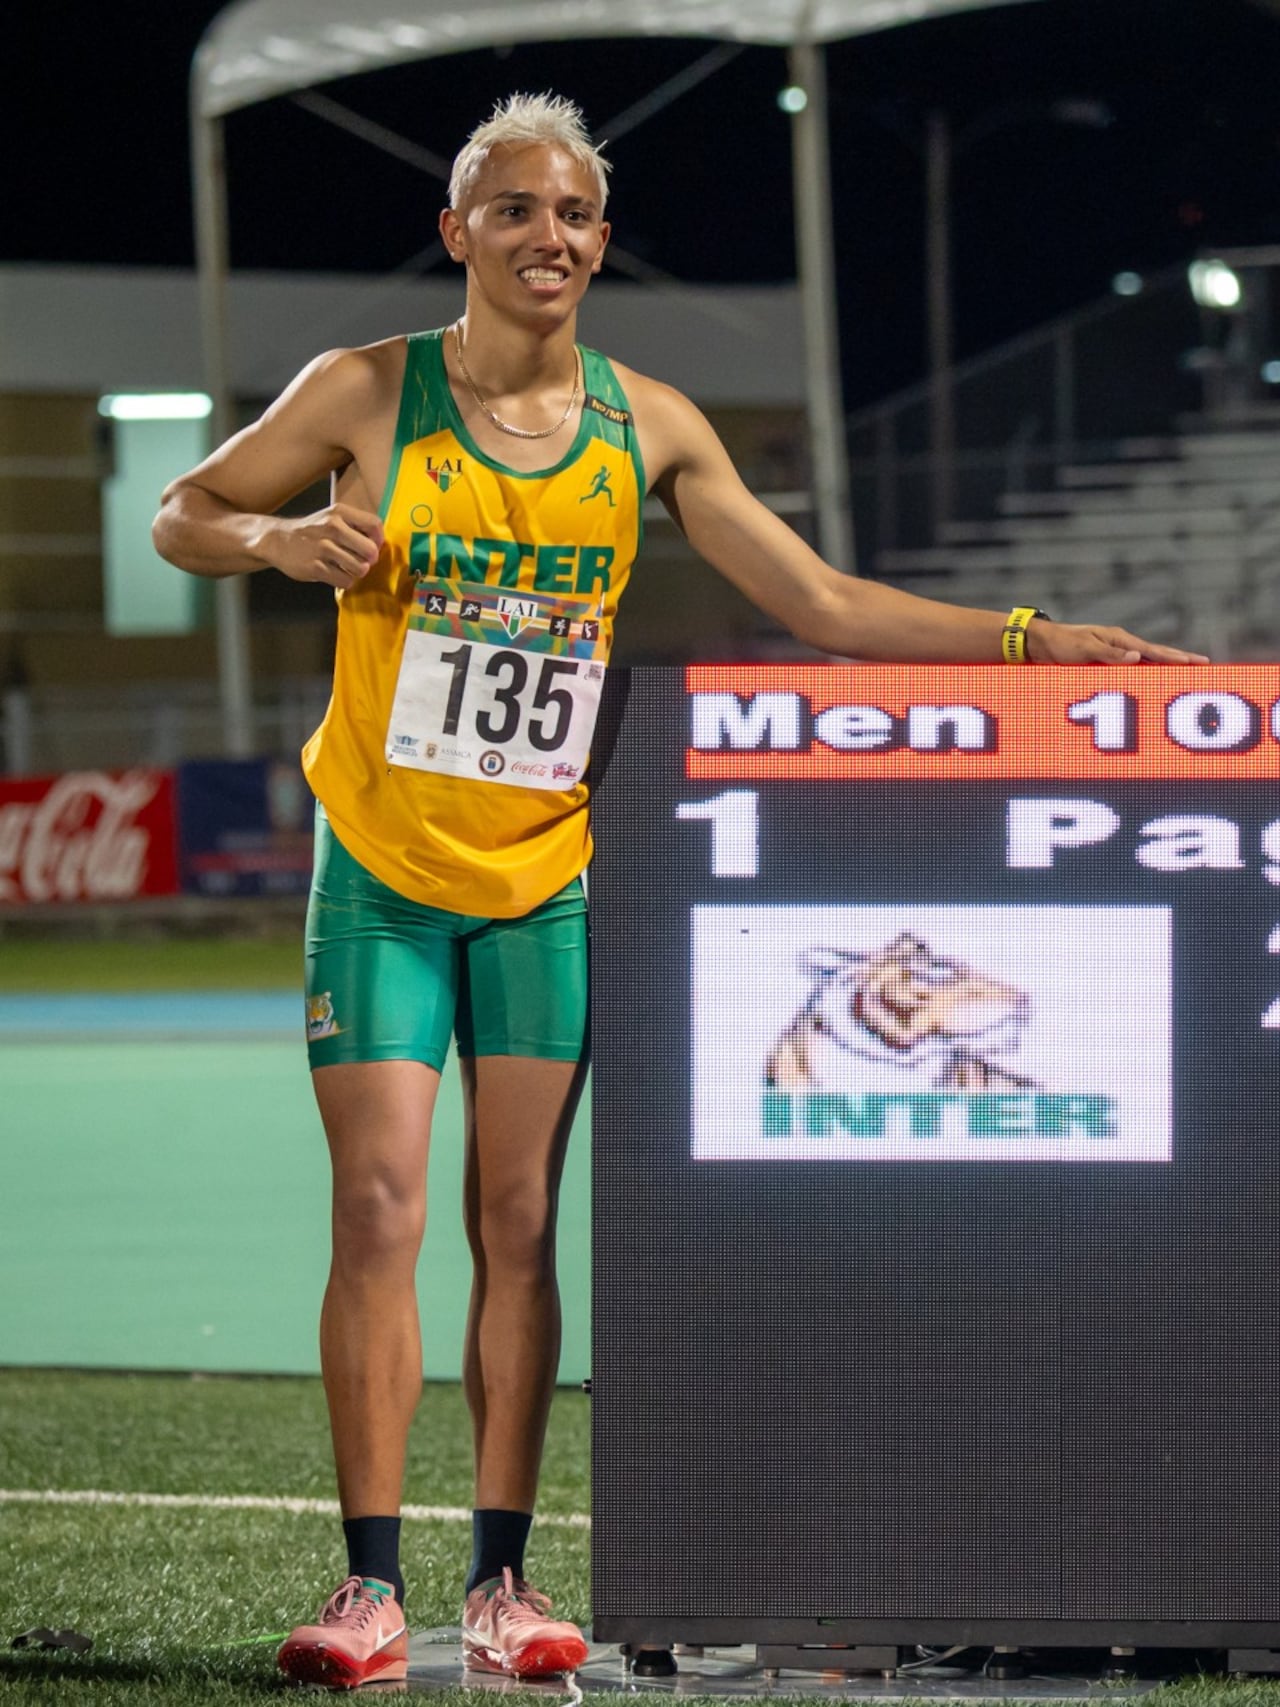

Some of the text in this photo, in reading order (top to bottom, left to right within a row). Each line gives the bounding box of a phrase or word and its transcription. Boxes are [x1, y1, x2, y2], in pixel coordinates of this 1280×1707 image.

[426, 457, 463, 473] LAI
[409, 532, 615, 594] INTER
[499, 598, 536, 617] LAI
[440, 644, 579, 752] 135
[691, 691, 990, 751] Men
[675, 790, 760, 878] 1
[762, 1092, 1118, 1139] INTER
